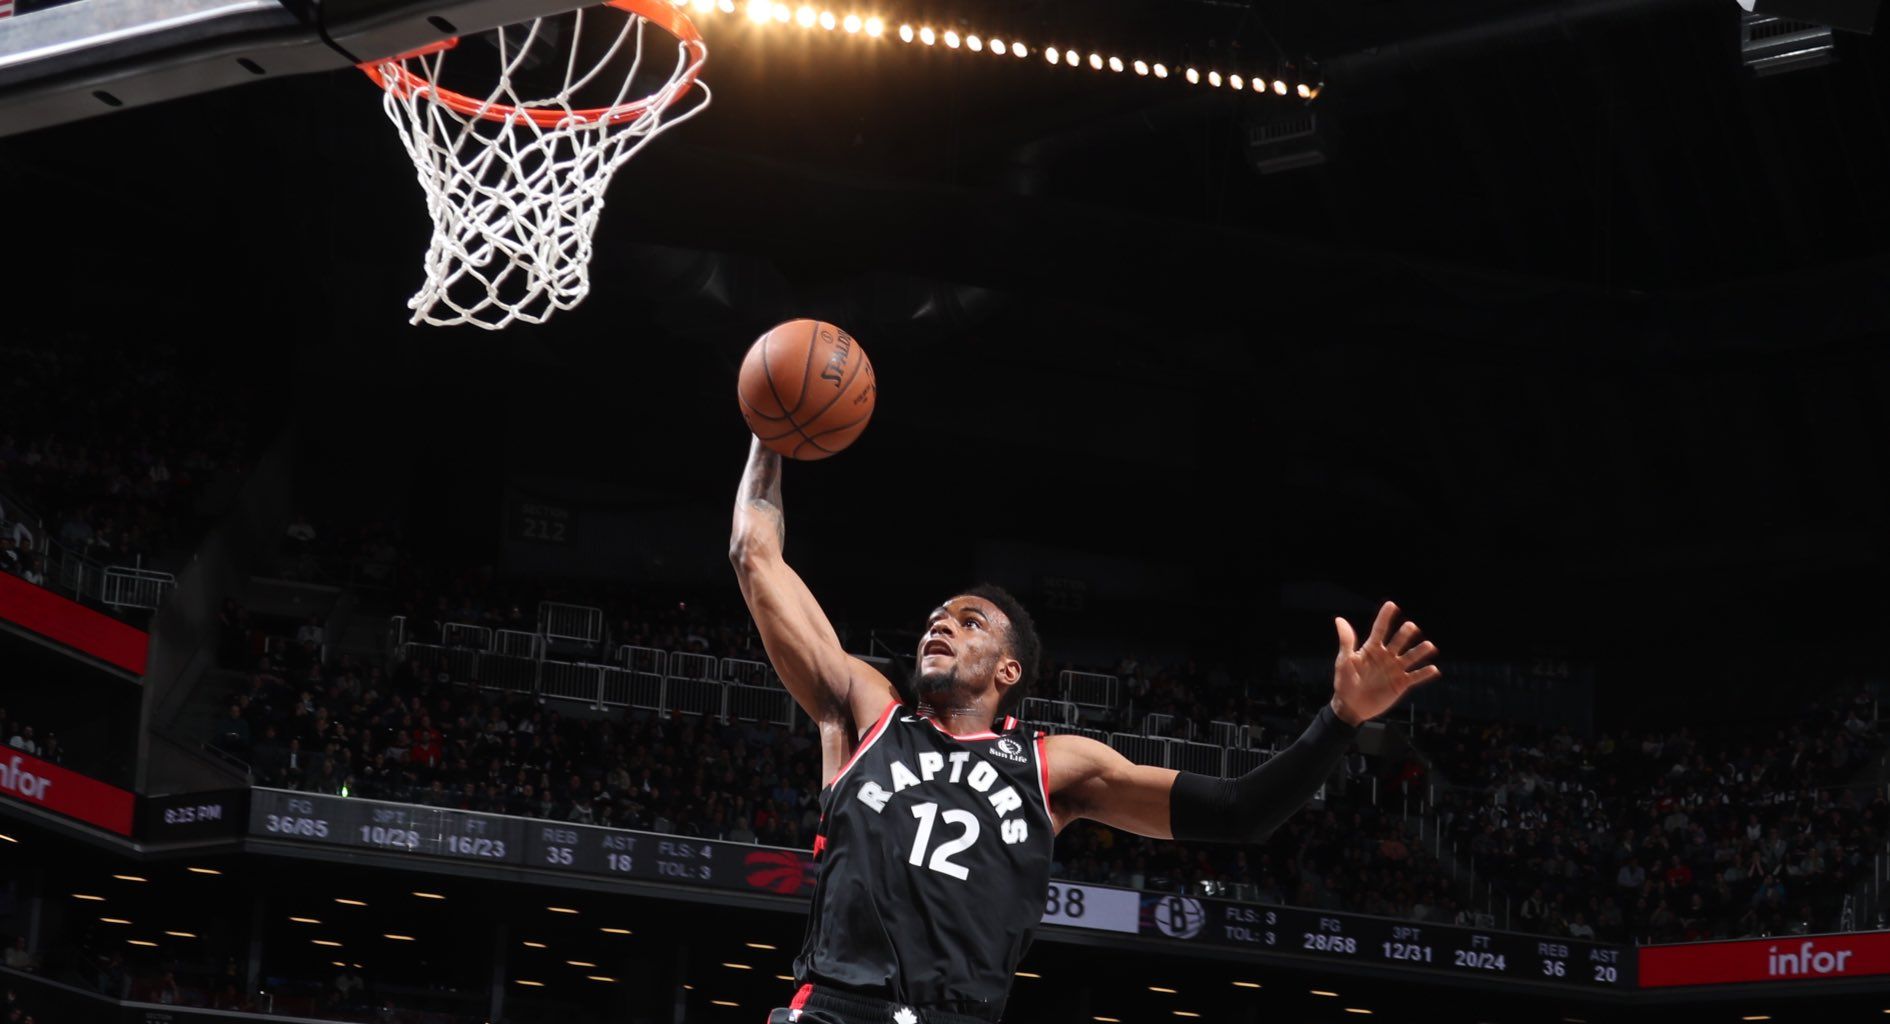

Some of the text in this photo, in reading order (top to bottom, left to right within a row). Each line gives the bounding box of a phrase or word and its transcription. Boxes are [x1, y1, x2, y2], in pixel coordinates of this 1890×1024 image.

[857, 751, 1028, 844] RAPTORS
[266, 814, 330, 839] 36/85
[465, 818, 488, 835] FT
[360, 825, 421, 849] 10/28
[541, 827, 579, 846] REB
[602, 835, 637, 852] AST
[908, 802, 980, 880] 12
[448, 835, 506, 859] 16/23
[546, 846, 574, 866] 35
[699, 845, 713, 860] 4
[607, 853, 633, 873] 18
[1226, 907, 1278, 926] FLS: 3
[1319, 917, 1342, 934] FG
[1225, 925, 1277, 946] TOL: 3
[1303, 932, 1358, 954] 28/58
[1392, 926, 1422, 941] 3PT
[1471, 935, 1492, 949] FT
[1382, 941, 1433, 963] 12/31
[1538, 942, 1569, 957] REB
[1589, 949, 1619, 965] AST
[1768, 941, 1853, 976] infor
[1454, 950, 1507, 971] 20/24
[1542, 960, 1566, 978] 36
[1594, 965, 1618, 983] 20
